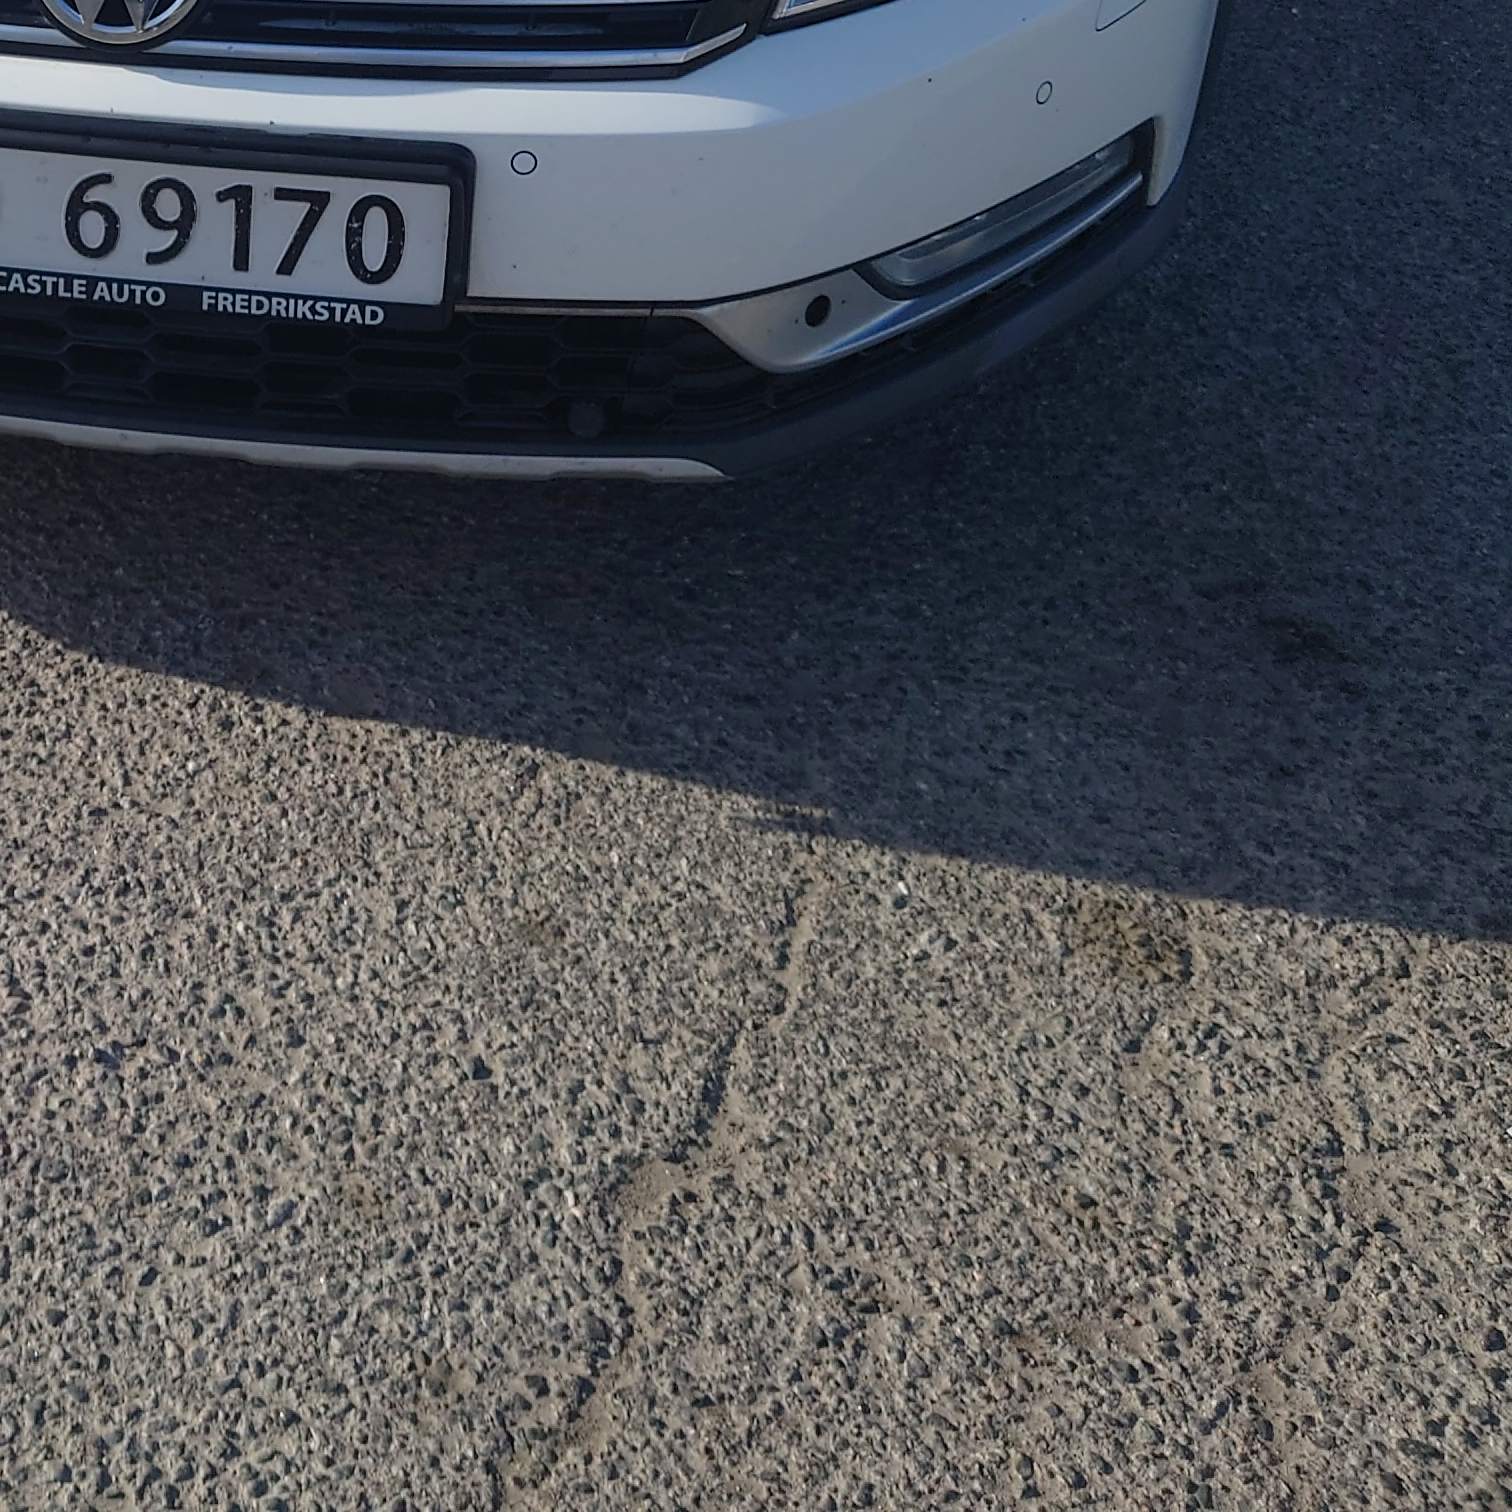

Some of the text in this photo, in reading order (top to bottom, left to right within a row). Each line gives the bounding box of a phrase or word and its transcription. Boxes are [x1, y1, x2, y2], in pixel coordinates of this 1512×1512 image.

[64, 172, 406, 285] 69170
[92, 281, 166, 306] AUTO
[202, 291, 385, 325] FREDRIKSTAD
